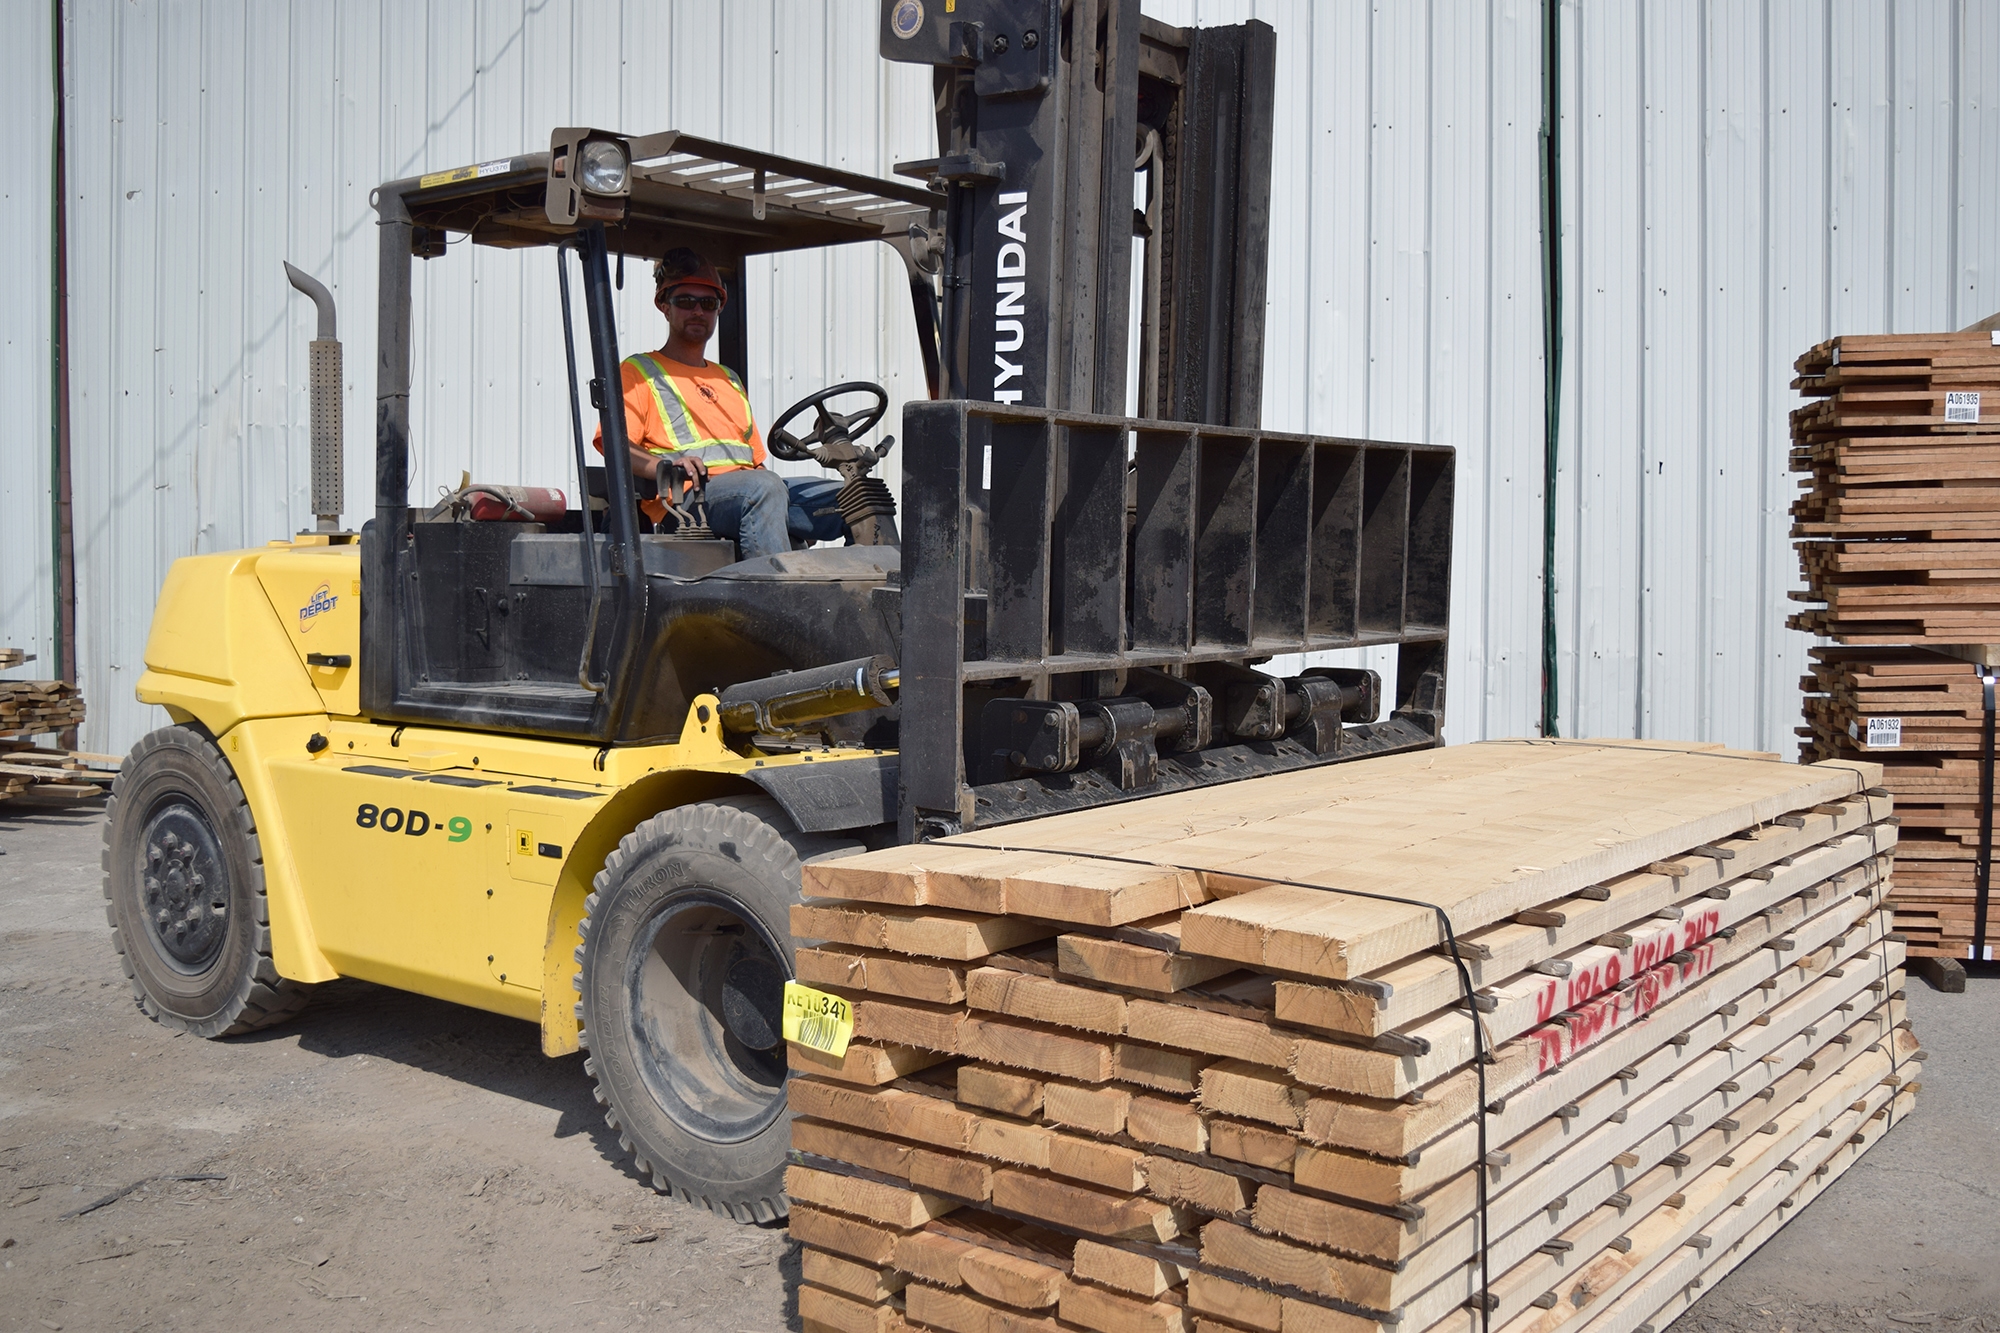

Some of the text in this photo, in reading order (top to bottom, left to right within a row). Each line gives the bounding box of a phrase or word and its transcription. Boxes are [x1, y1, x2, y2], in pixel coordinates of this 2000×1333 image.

[310, 590, 328, 603] LIFT
[300, 595, 338, 619] DEPOT
[1868, 719, 1899, 730] A061932
[356, 803, 472, 843] 80D-9
